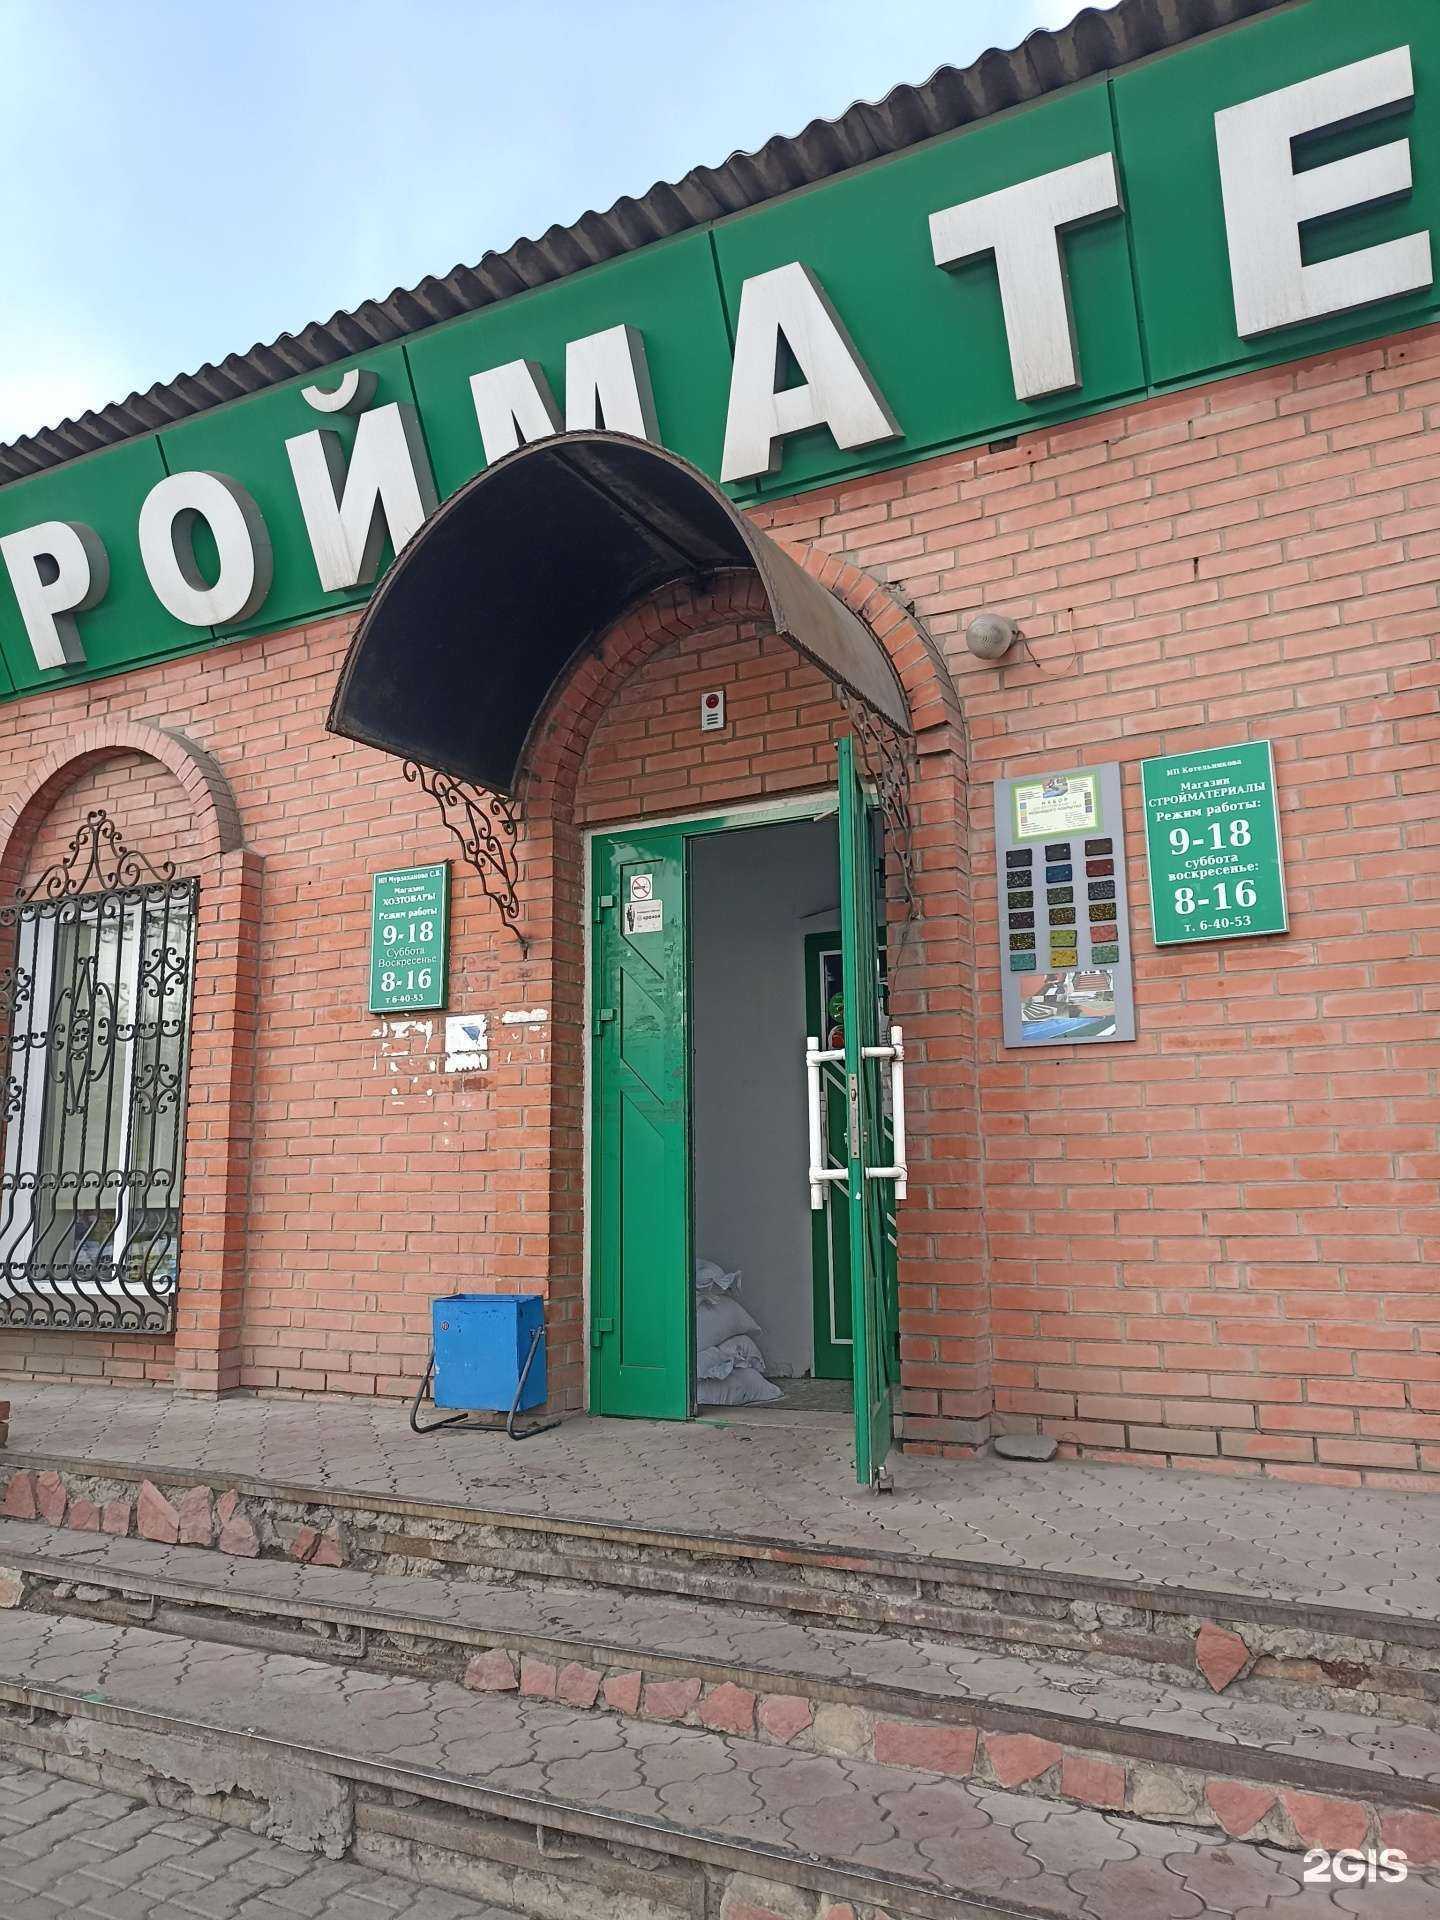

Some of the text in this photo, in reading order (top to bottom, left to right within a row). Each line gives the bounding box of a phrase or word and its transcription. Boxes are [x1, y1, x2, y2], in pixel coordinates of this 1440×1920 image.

[1180, 778, 1230, 791] Магазин
[1148, 782, 1266, 807] СТРОЙМАТЕРИАЛЫ
[1156, 800, 1261, 822] Режим работы:
[1169, 819, 1251, 855] 9-18
[1185, 854, 1239, 870] суббота
[1168, 863, 1259, 881] воскресенье:
[383, 893, 436, 906] ХОЗТОВАРЫ
[1174, 879, 1257, 914] 8-16
[1200, 915, 1252, 931] 6-40-53
[382, 921, 434, 946] 9-18
[386, 946, 425, 959] Суббота
[378, 956, 437, 968] Воскресенье
[381, 968, 432, 992] 8-16
